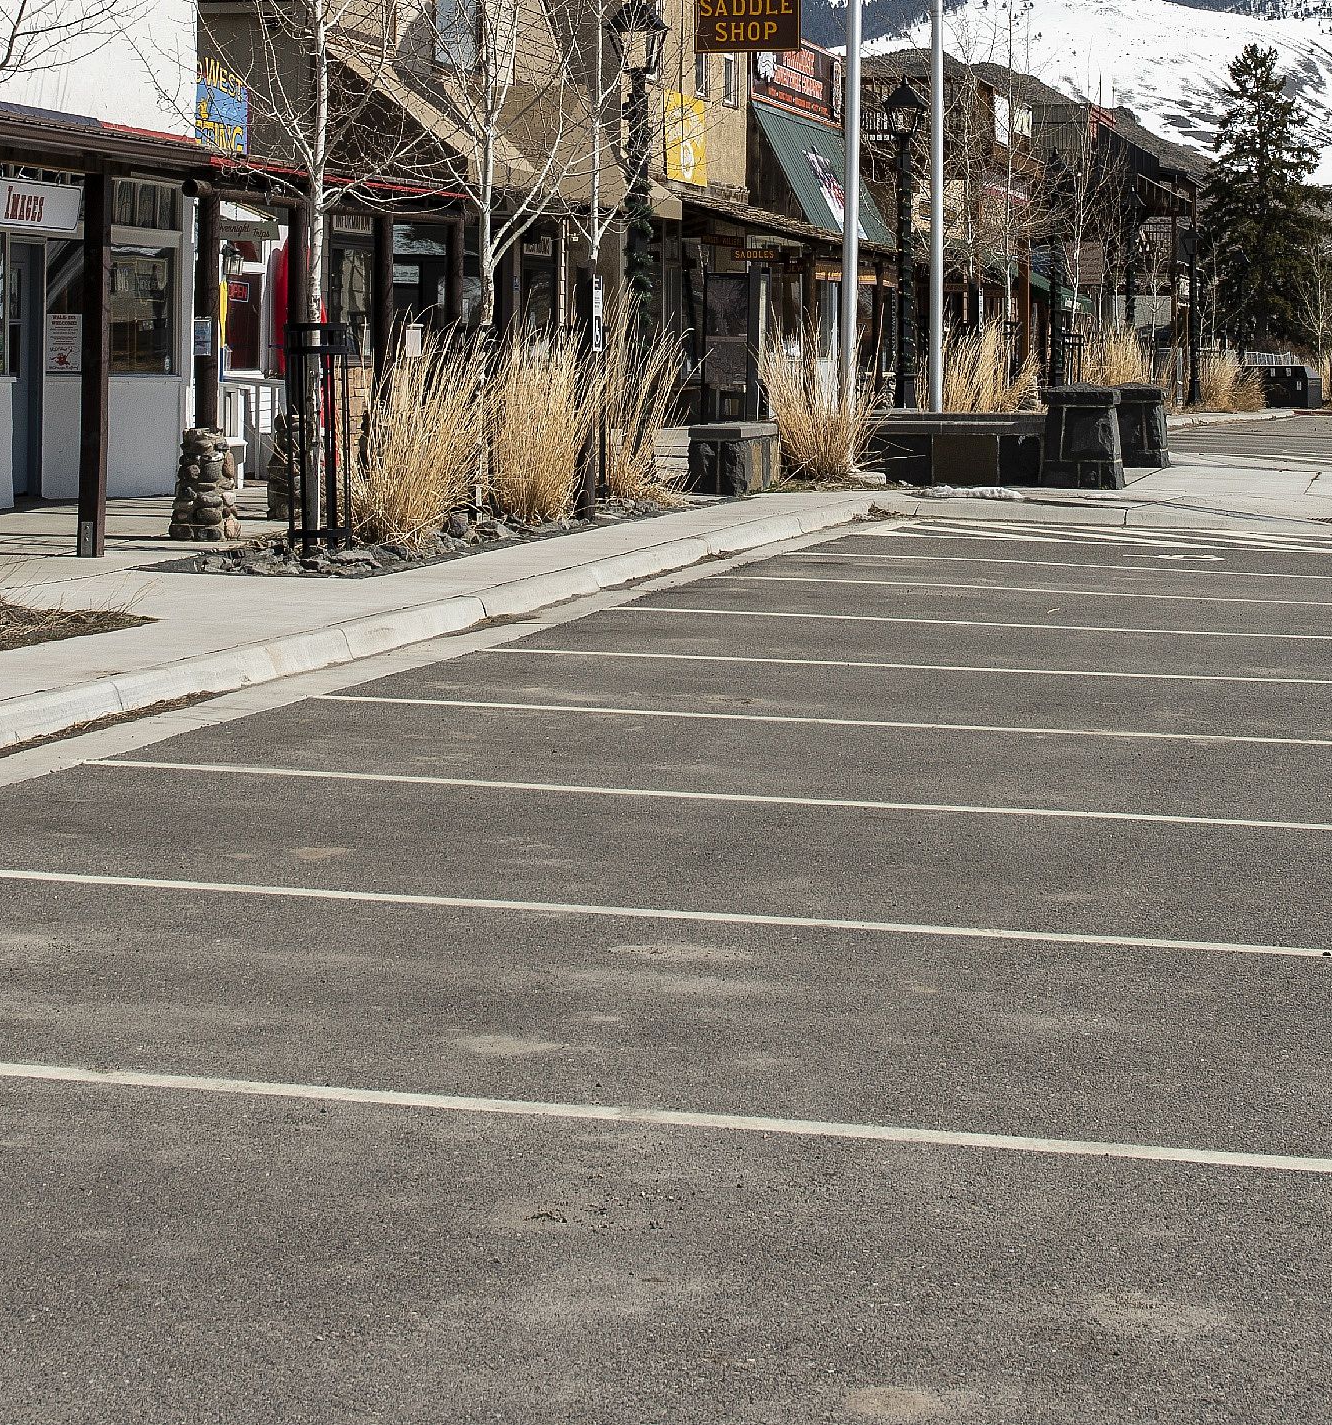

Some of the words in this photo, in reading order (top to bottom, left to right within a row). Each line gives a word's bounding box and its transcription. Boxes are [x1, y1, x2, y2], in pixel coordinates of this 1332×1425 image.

[715, 21, 778, 42] SHOP
[205, 56, 243, 102] WEST
[3, 185, 45, 223] IMAGES
[734, 249, 775, 259] SADDLES
